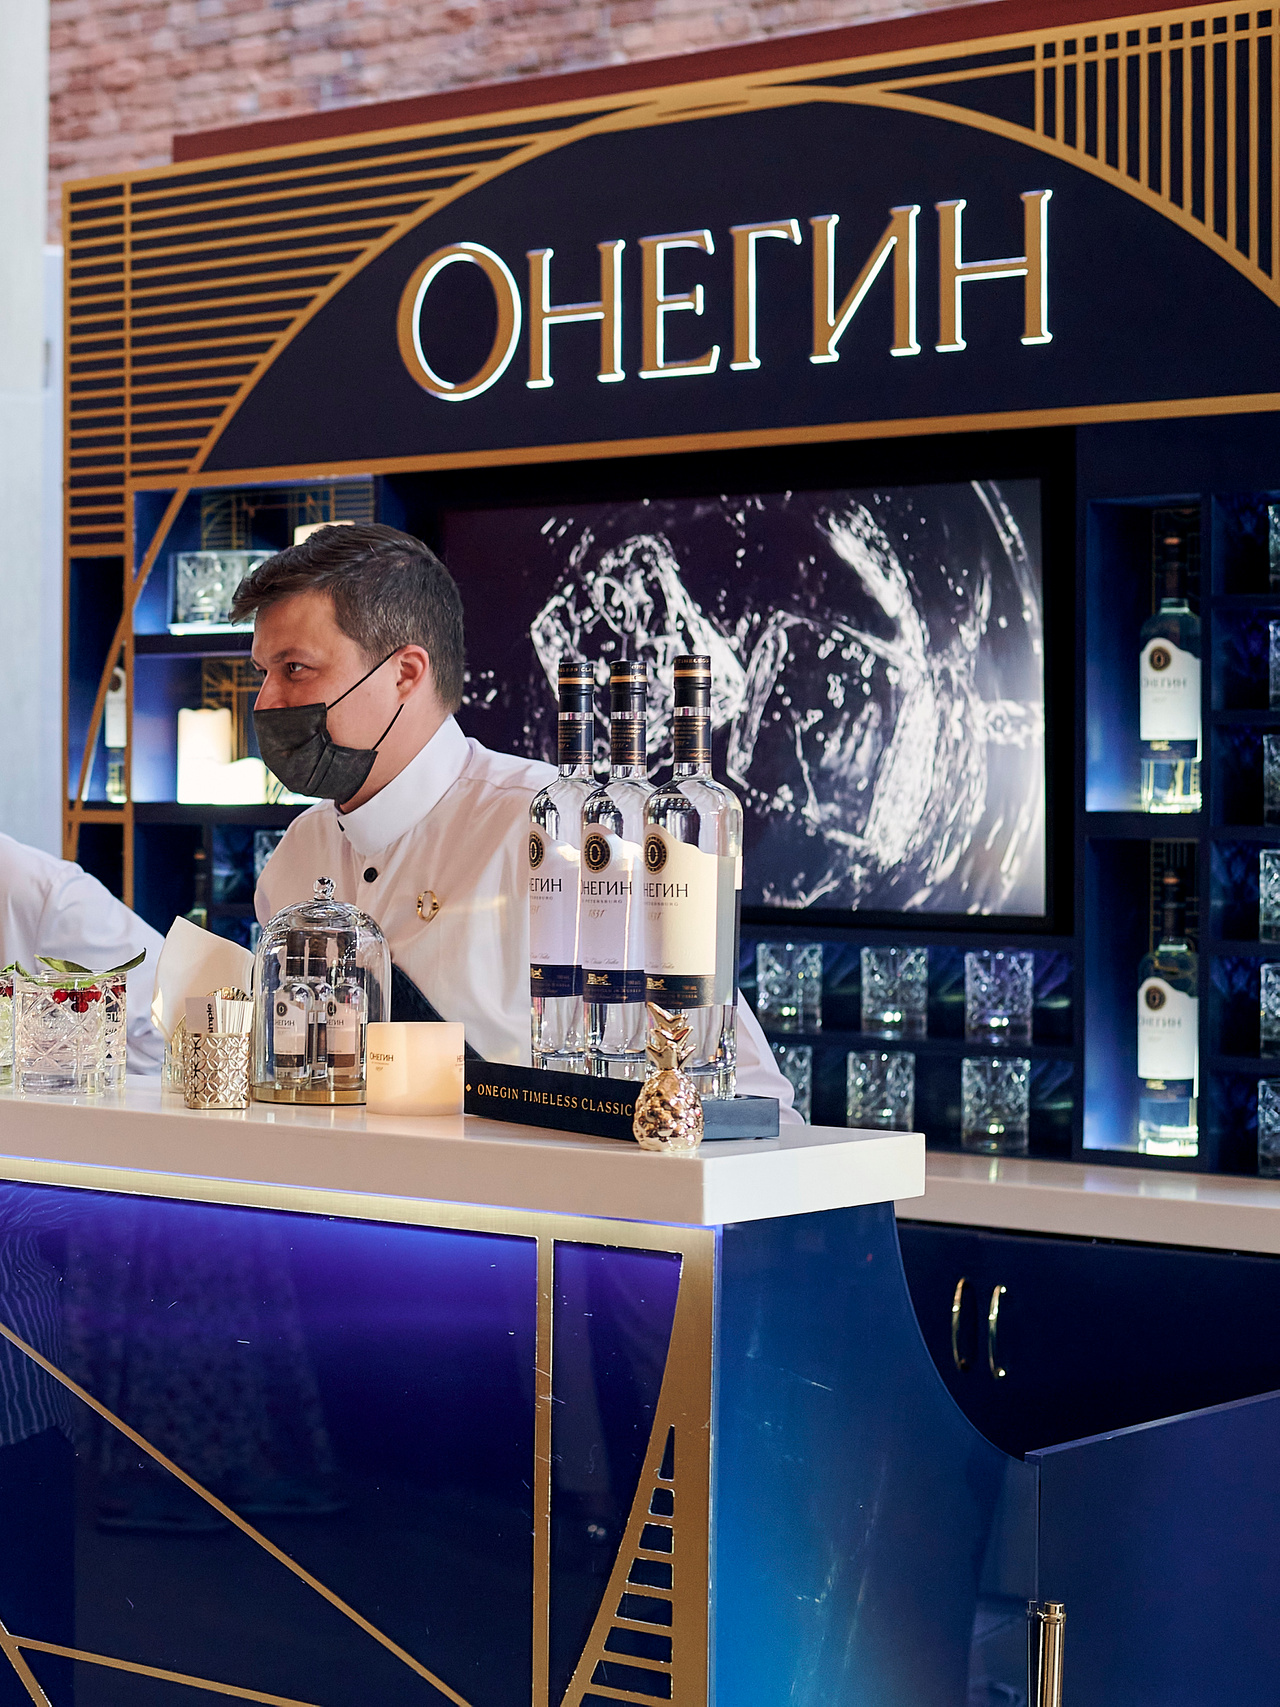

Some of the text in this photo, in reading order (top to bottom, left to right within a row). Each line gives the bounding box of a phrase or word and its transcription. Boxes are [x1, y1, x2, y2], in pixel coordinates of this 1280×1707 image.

[397, 189, 1052, 401] ОНЕГИН
[477, 1083, 633, 1117] ONEGIN TIMELESS CLASSIC
